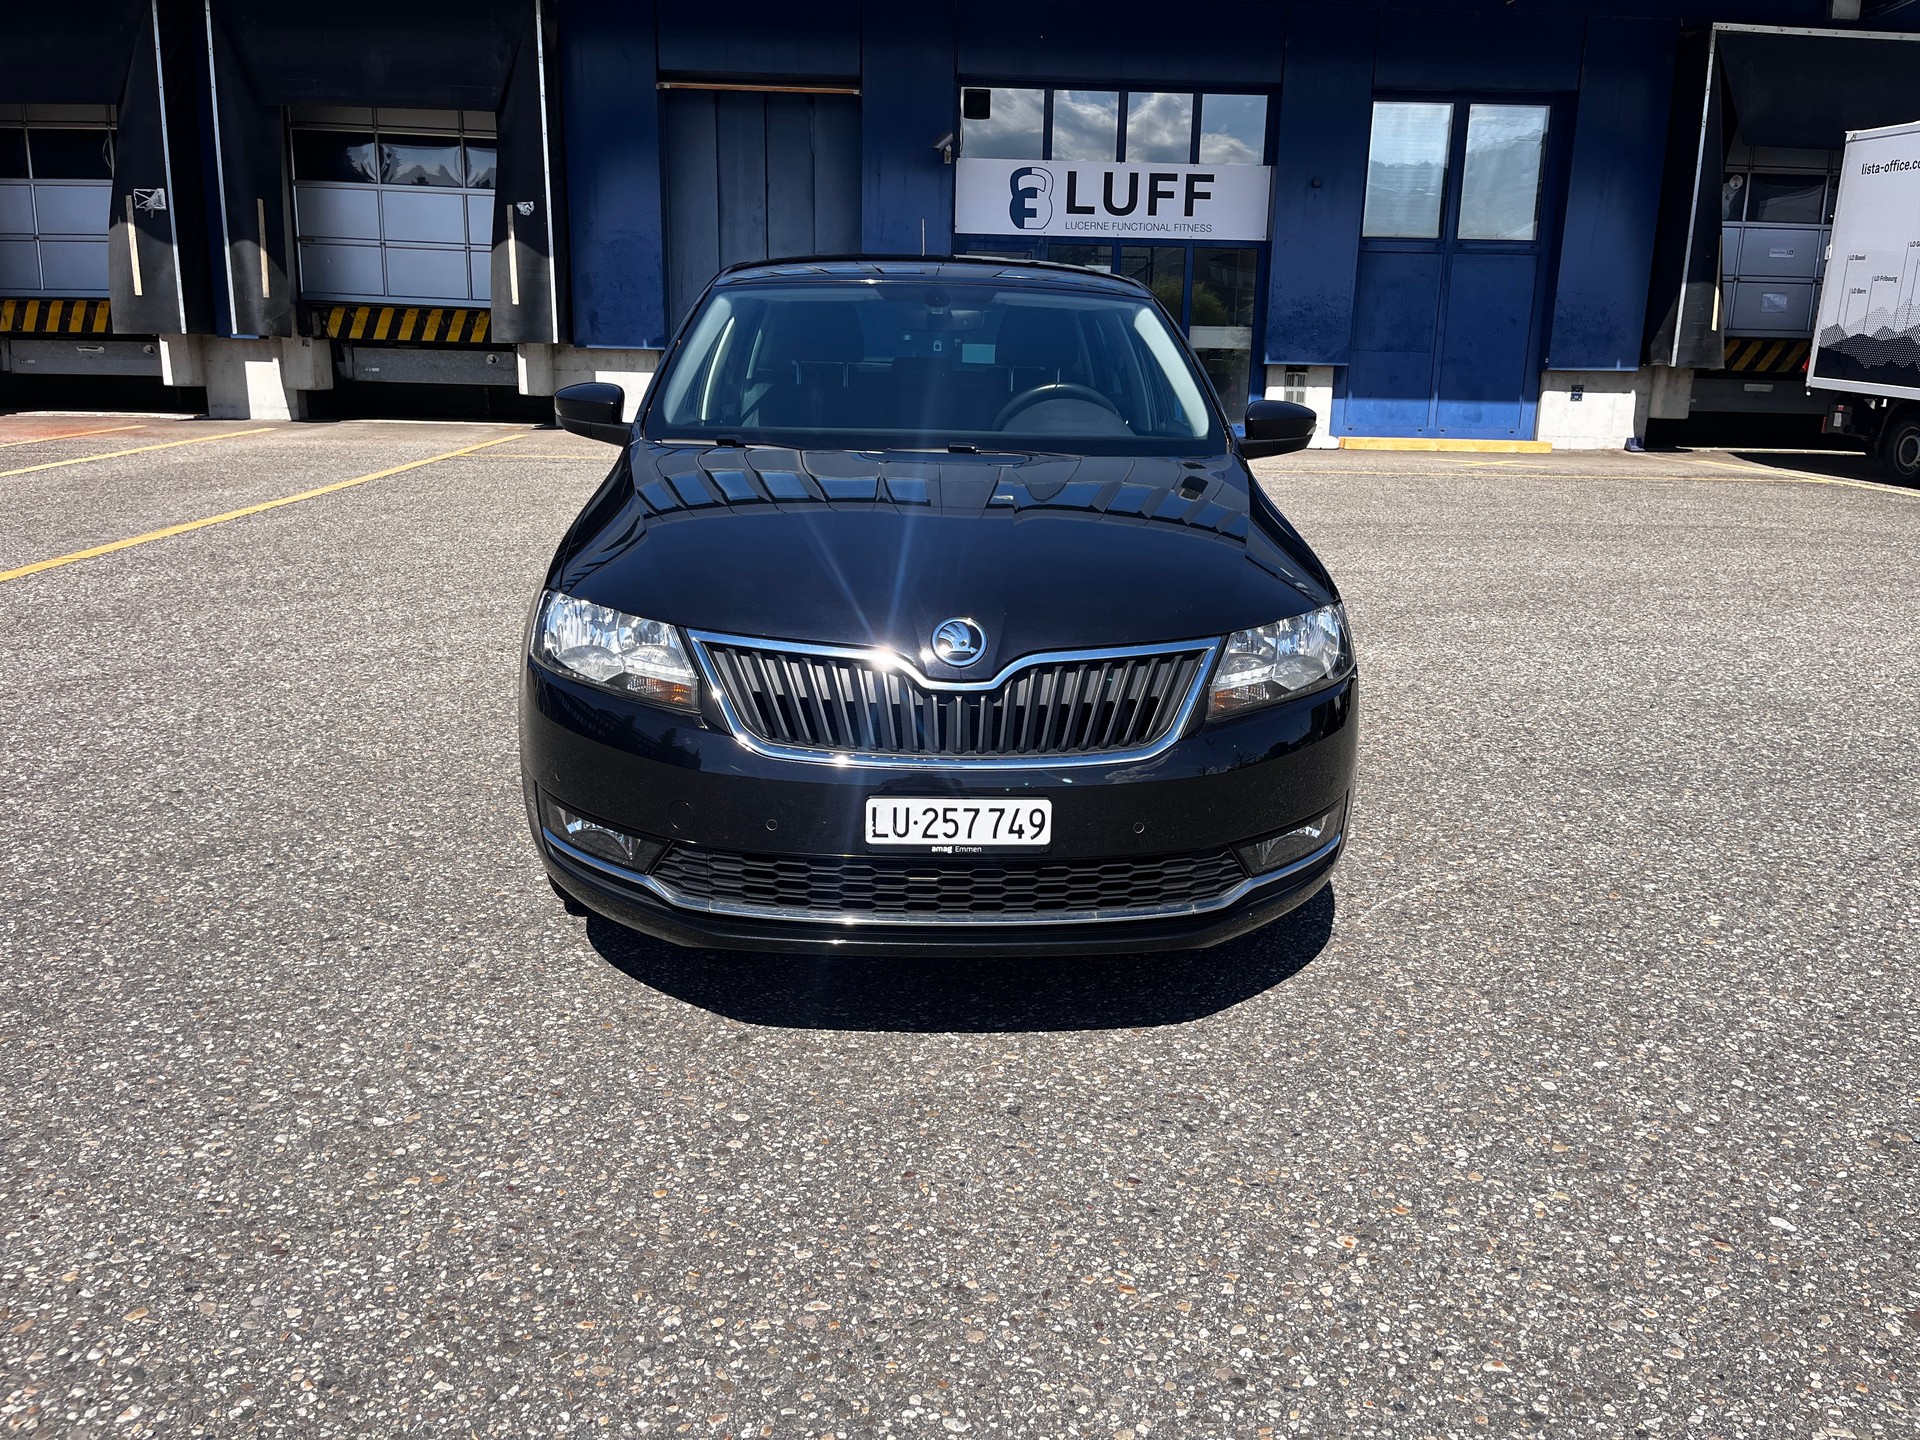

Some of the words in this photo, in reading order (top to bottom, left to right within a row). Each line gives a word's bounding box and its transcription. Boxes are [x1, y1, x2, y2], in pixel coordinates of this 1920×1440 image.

[1066, 171, 1215, 217] LUFF
[1065, 221, 1110, 231] LUCERNE
[1112, 222, 1171, 232] FUNCTIONAL
[1174, 223, 1213, 233] FITNESS
[931, 845, 953, 854] amag
[955, 845, 982, 853] Emmen
